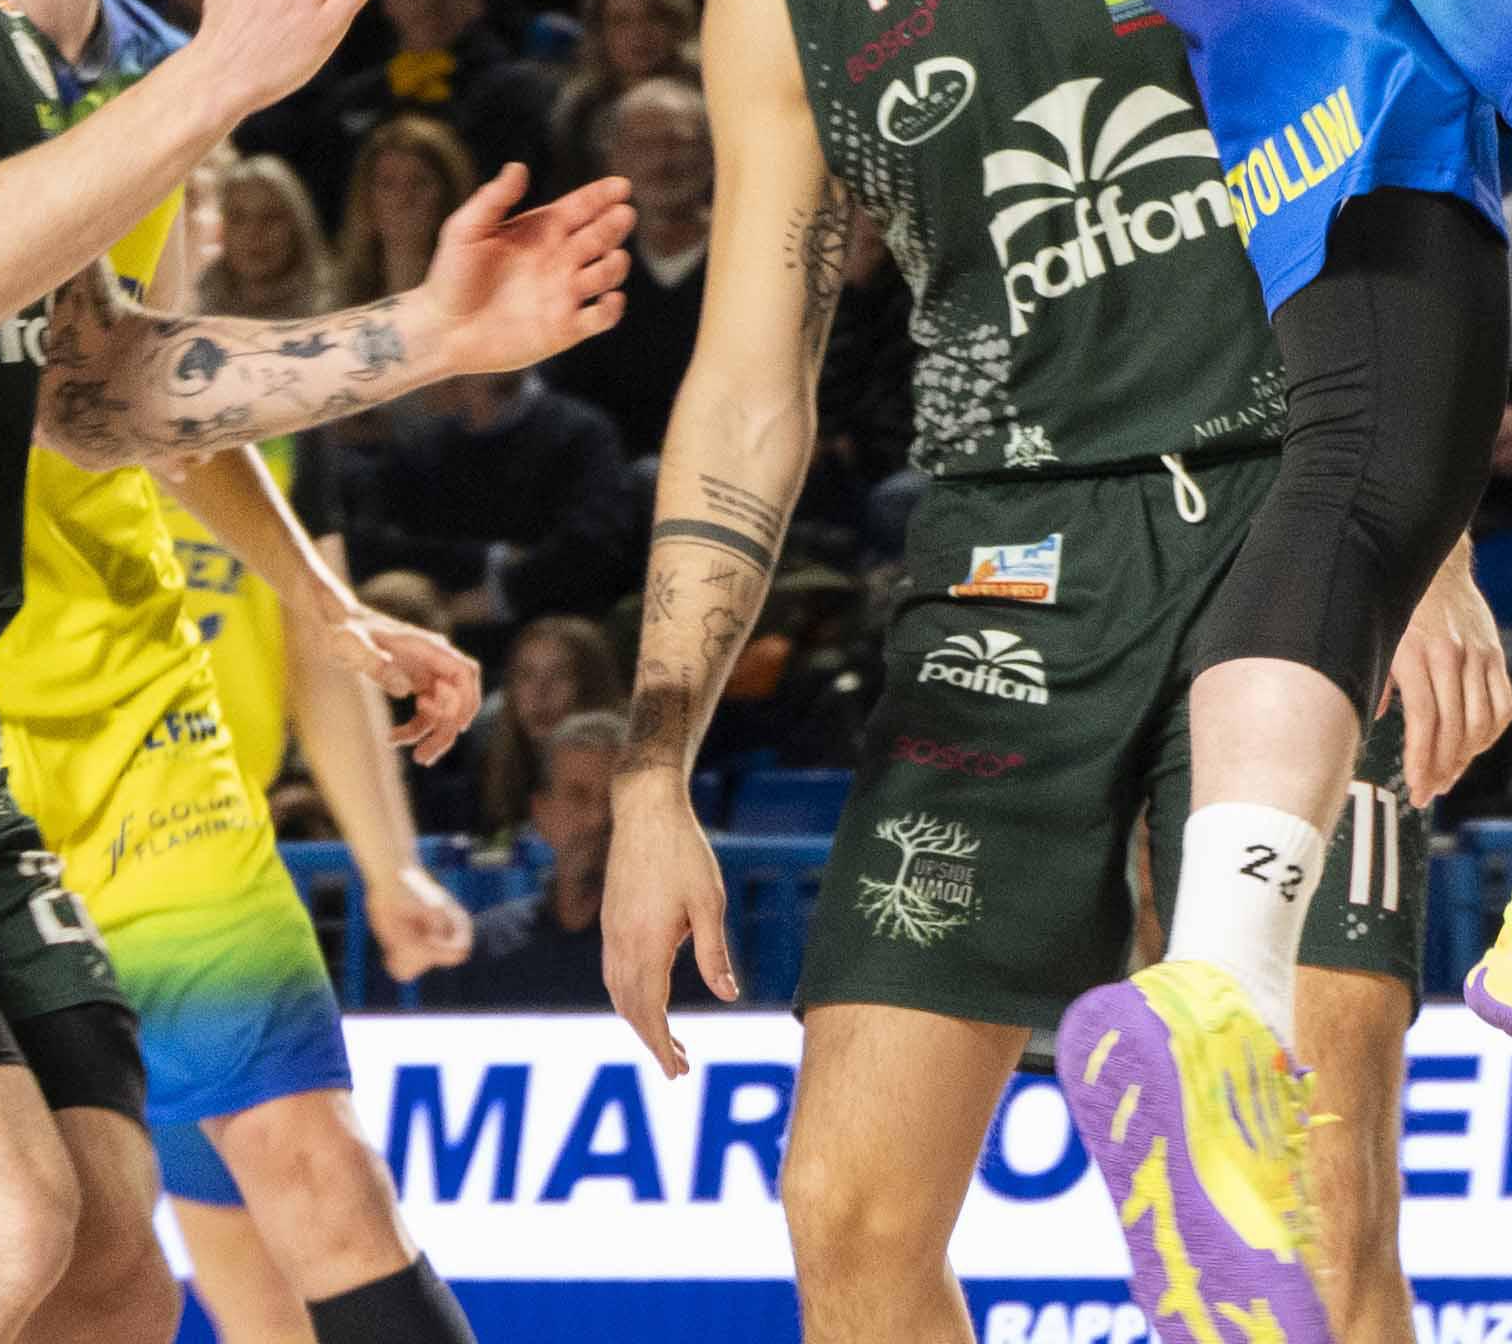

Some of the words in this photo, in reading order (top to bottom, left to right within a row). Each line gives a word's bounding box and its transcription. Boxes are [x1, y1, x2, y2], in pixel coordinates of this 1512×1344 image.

[1003, 178, 1237, 338] paffon
[1347, 780, 1400, 912] 11
[381, 1062, 1094, 1204] MARO
